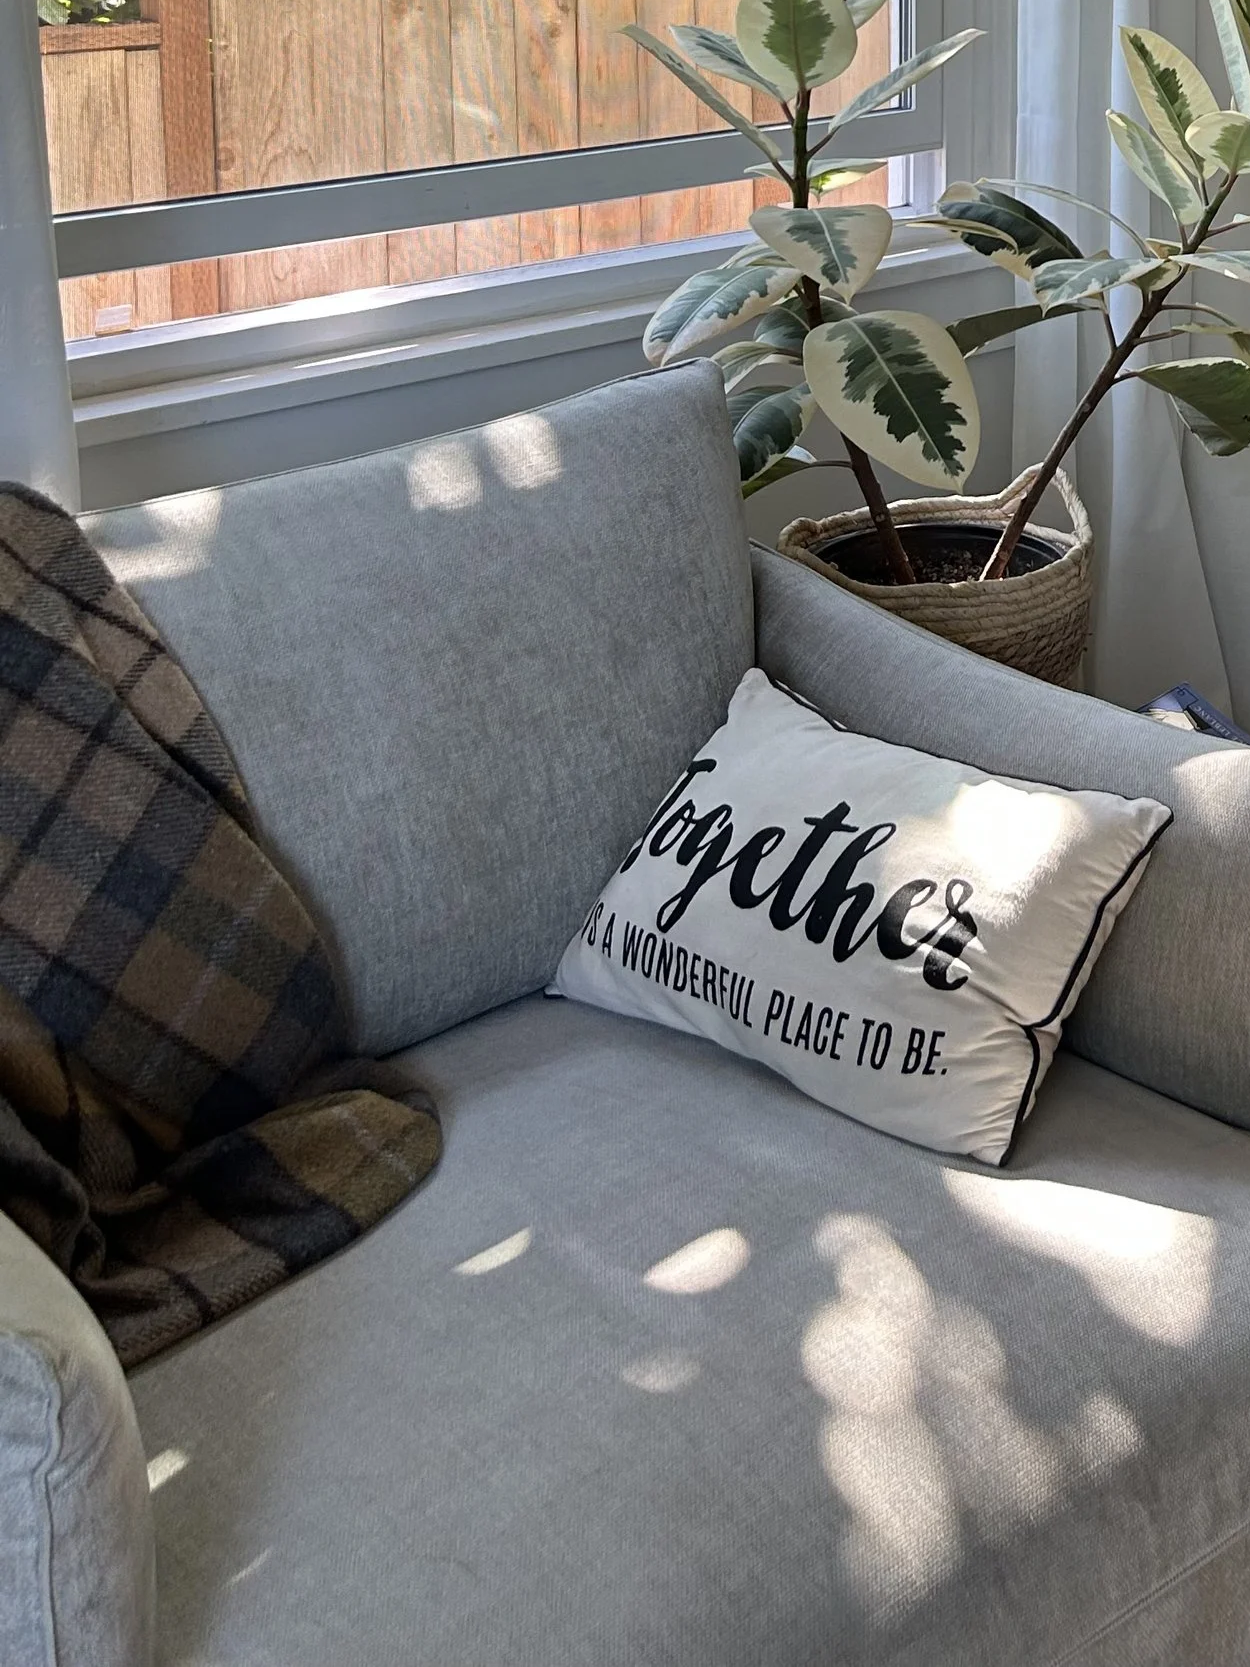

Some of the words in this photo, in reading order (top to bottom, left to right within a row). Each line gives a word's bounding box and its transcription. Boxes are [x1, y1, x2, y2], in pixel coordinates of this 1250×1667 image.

[619, 758, 980, 991] Together
[602, 912, 617, 959] A
[622, 920, 757, 1028] WONDERFUL
[763, 989, 851, 1061] PLACE
[856, 1018, 893, 1070] TO
[901, 1027, 948, 1077] BE.
